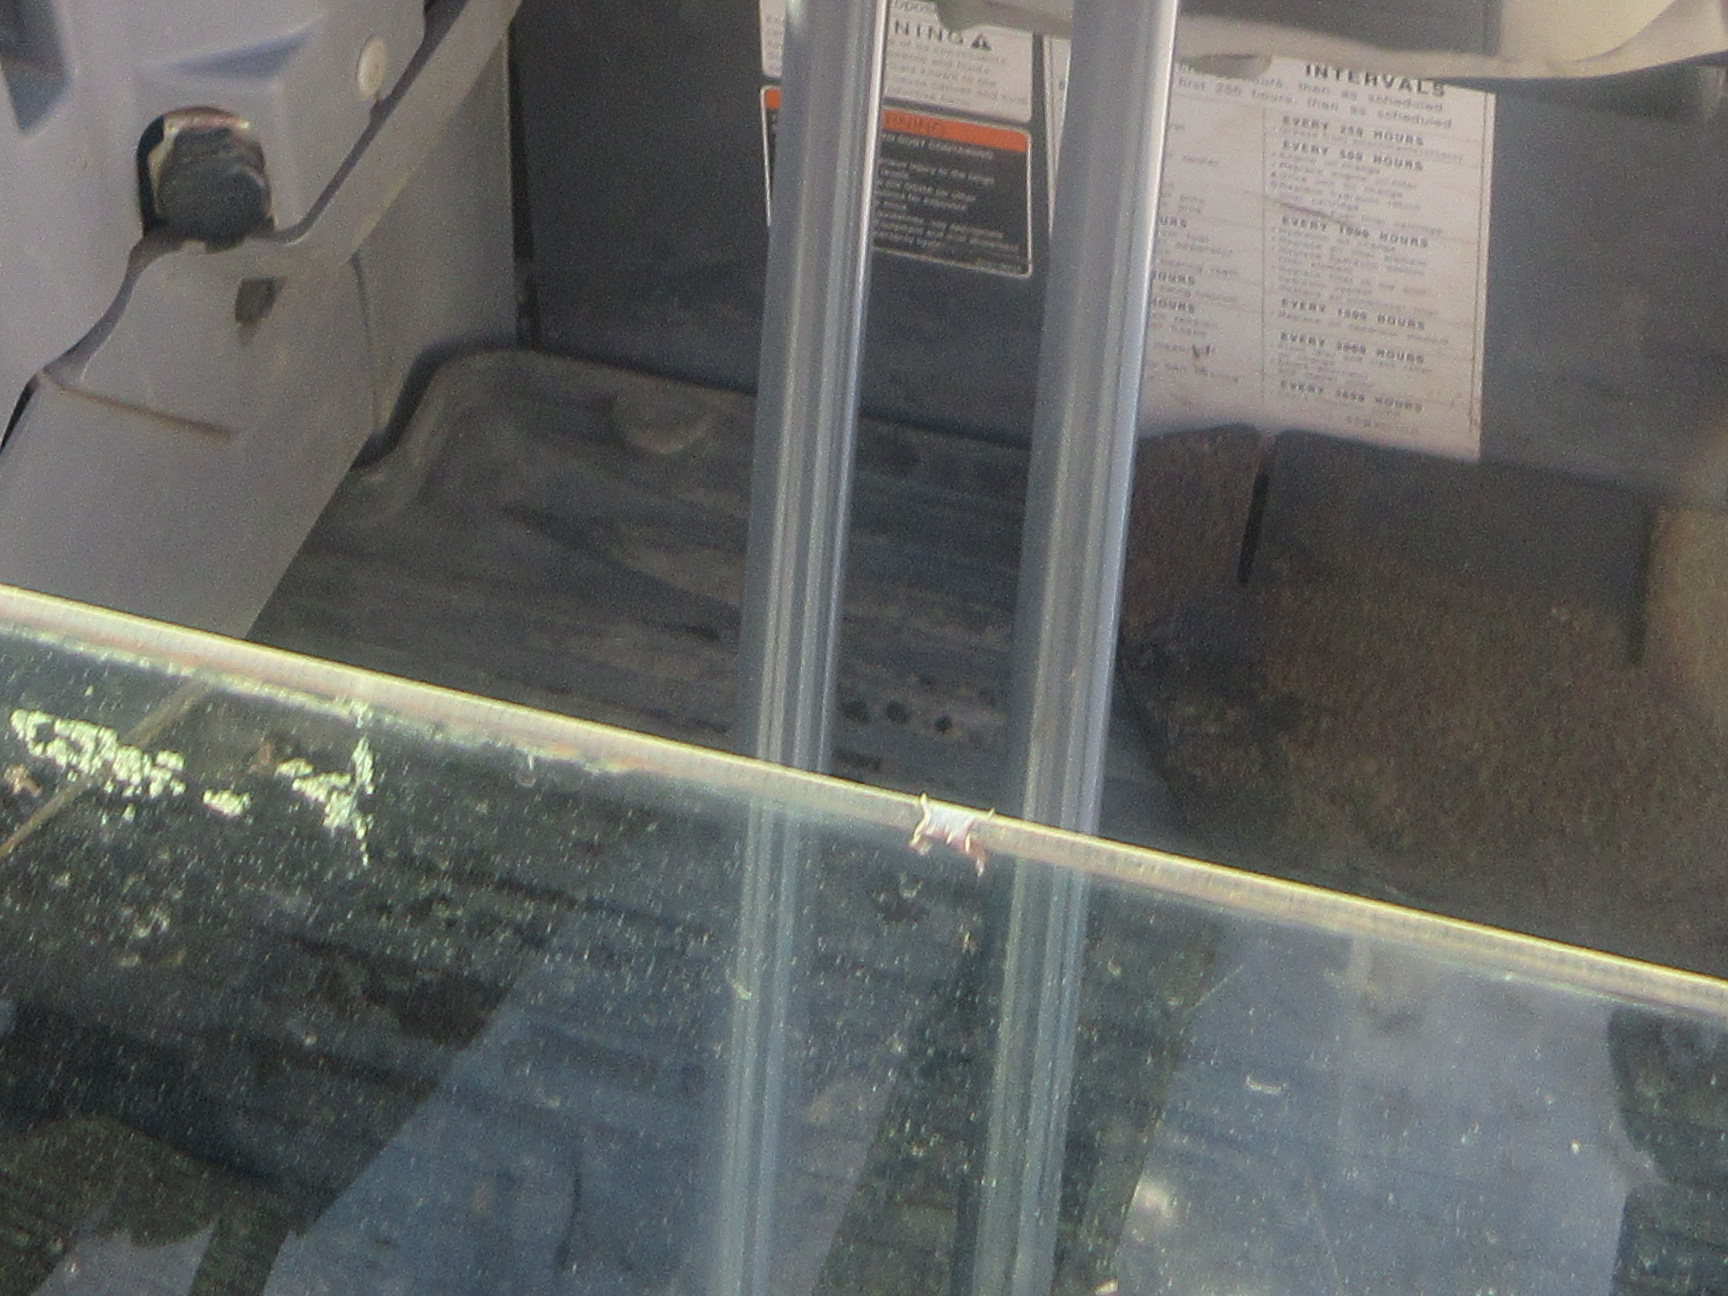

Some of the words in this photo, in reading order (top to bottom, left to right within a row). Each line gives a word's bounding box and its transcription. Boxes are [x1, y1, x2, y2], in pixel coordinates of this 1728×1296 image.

[1305, 62, 1446, 97] INTERVALS
[1282, 114, 1329, 131] EVERY
[1373, 129, 1425, 147] HOURS
[1307, 98, 1339, 112] then
[1377, 107, 1452, 130] scheduled
[1282, 139, 1329, 156] EVERY
[1373, 153, 1424, 172] HOURS
[1281, 215, 1328, 232] EVERY
[1379, 230, 1429, 249] HOURS
[1280, 297, 1327, 314] EVERY
[1376, 313, 1426, 331] HOURS
[1280, 331, 1326, 347] EVERY
[1375, 346, 1425, 365] HOURS
[1280, 379, 1325, 394] EVERY
[1373, 394, 1424, 413] HOURS
